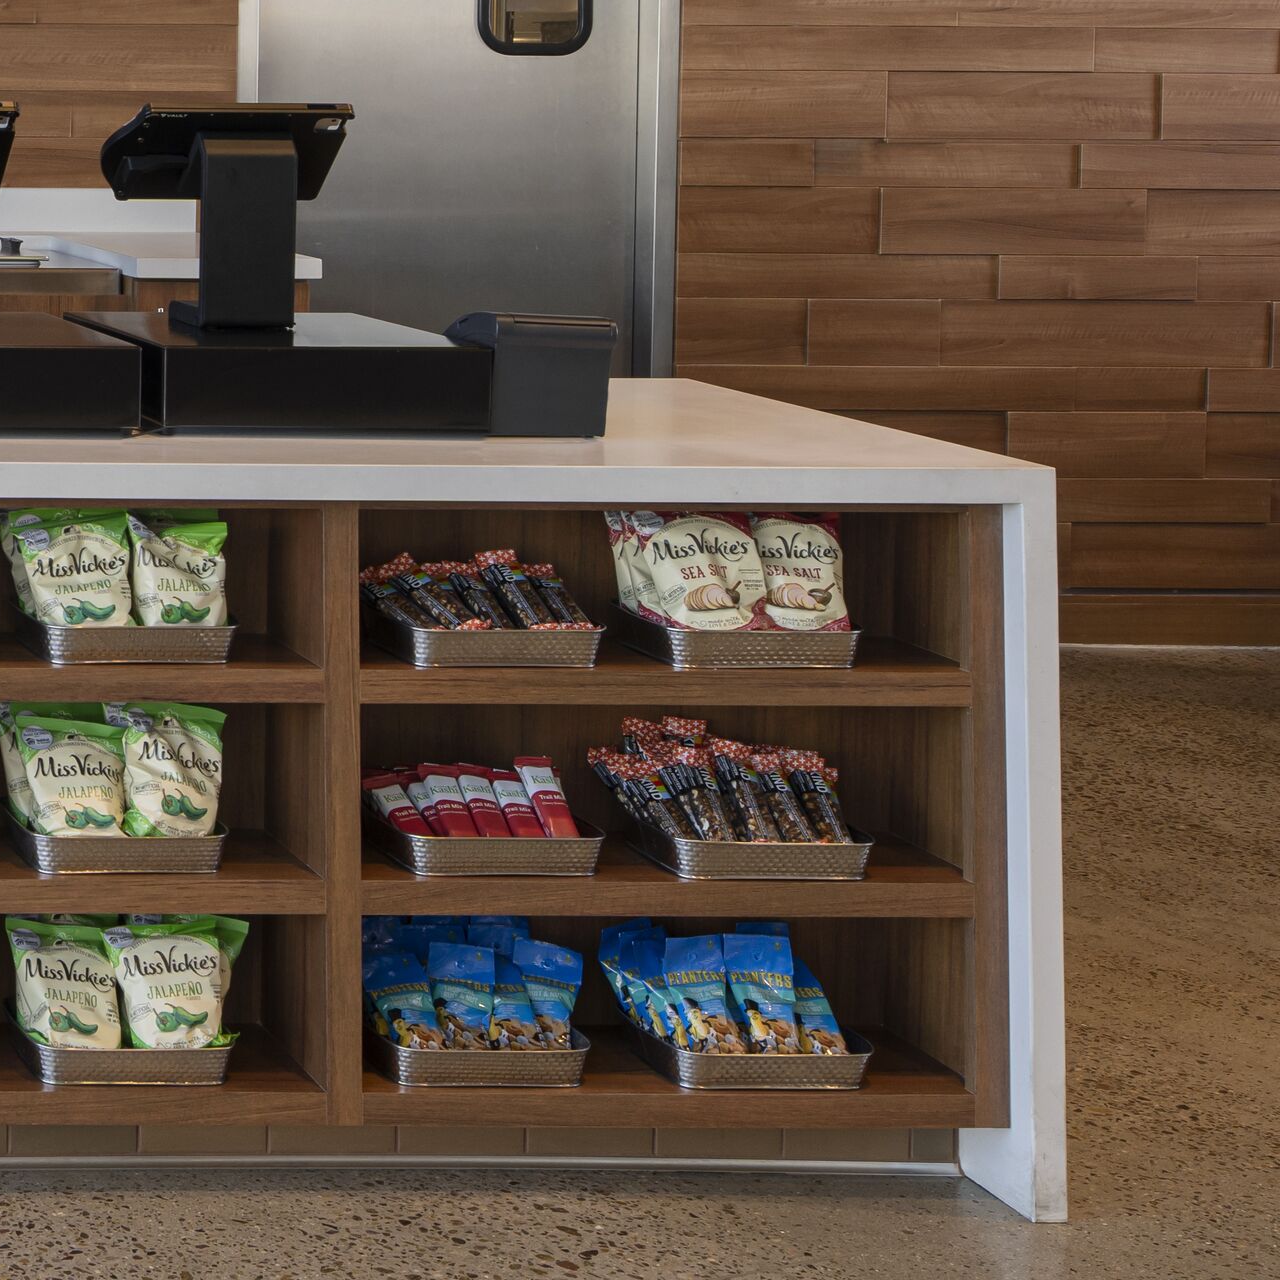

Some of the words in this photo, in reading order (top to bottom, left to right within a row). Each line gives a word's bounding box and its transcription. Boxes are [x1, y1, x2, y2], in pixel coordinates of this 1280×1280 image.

[652, 539, 696, 565] Miss
[686, 528, 749, 562] Vickie's
[776, 531, 840, 565] Vickie's
[32, 558, 74, 579] Miss
[69, 546, 127, 576] Vickie's
[680, 566, 705, 580] SEA
[767, 564, 790, 577] SEA
[793, 566, 822, 579] SALT
[34, 756, 78, 778] Miss
[430, 784, 459, 795] Kashi
[639, 777, 665, 801] KIND
[123, 955, 166, 980] Miss
[155, 945, 218, 976] Vickie's
[25, 959, 66, 982] Miss
[57, 959, 117, 993] Vickie's
[731, 970, 792, 989] PLANTERS
